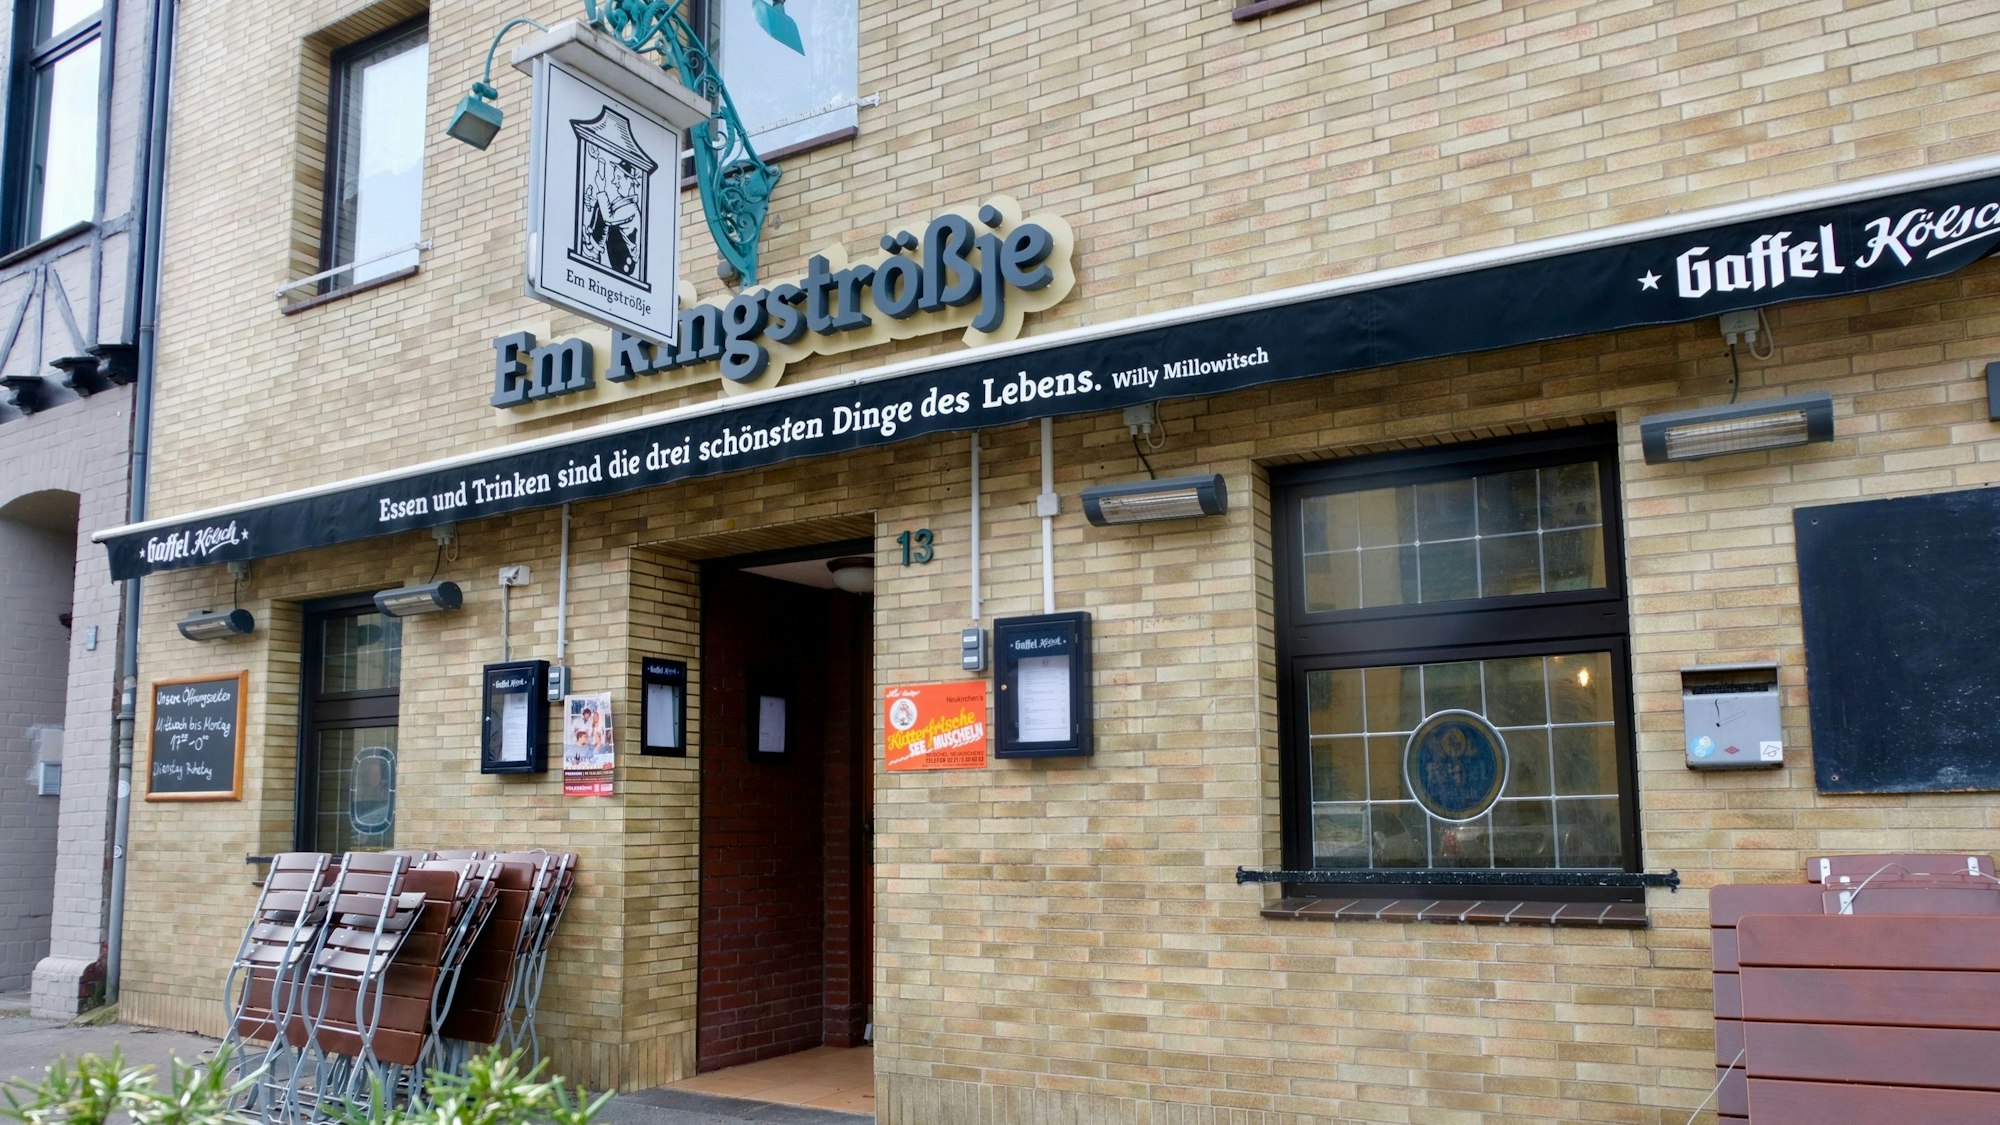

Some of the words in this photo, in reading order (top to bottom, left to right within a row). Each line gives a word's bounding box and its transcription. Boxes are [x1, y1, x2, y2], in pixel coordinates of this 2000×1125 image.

[1676, 222, 1845, 299] Gaffel
[1855, 202, 2000, 268] Kölsc
[566, 268, 586, 288] Em
[588, 277, 652, 317] Ringströßje
[490, 330, 596, 409] Em
[378, 497, 429, 522] Essen
[433, 482, 467, 512] und
[472, 471, 551, 504] Trinken
[557, 455, 602, 488] sind
[608, 449, 640, 478] die
[645, 436, 691, 471] drei
[698, 416, 824, 461] schönsten
[832, 401, 913, 437] Dinge
[920, 386, 971, 418] des
[982, 370, 1102, 409] Lebens.
[1111, 366, 1159, 389] Willy
[1163, 346, 1270, 380] Millowitsch
[146, 530, 190, 563] Gaffel
[190, 520, 240, 557] Kölsch
[896, 528, 934, 567] 13
[1014, 639, 1038, 650] Gaffel
[157, 692, 181, 706] Unsere
[182, 686, 231, 708] Öffnungszeiten
[155, 716, 187, 732] Mittwoch
[189, 717, 202, 731] bis
[203, 717, 231, 738] Montag
[933, 721, 984, 751] MUSCHELN
[153, 759, 183, 780] Dienstag
[186, 761, 212, 781] Ruhetag
